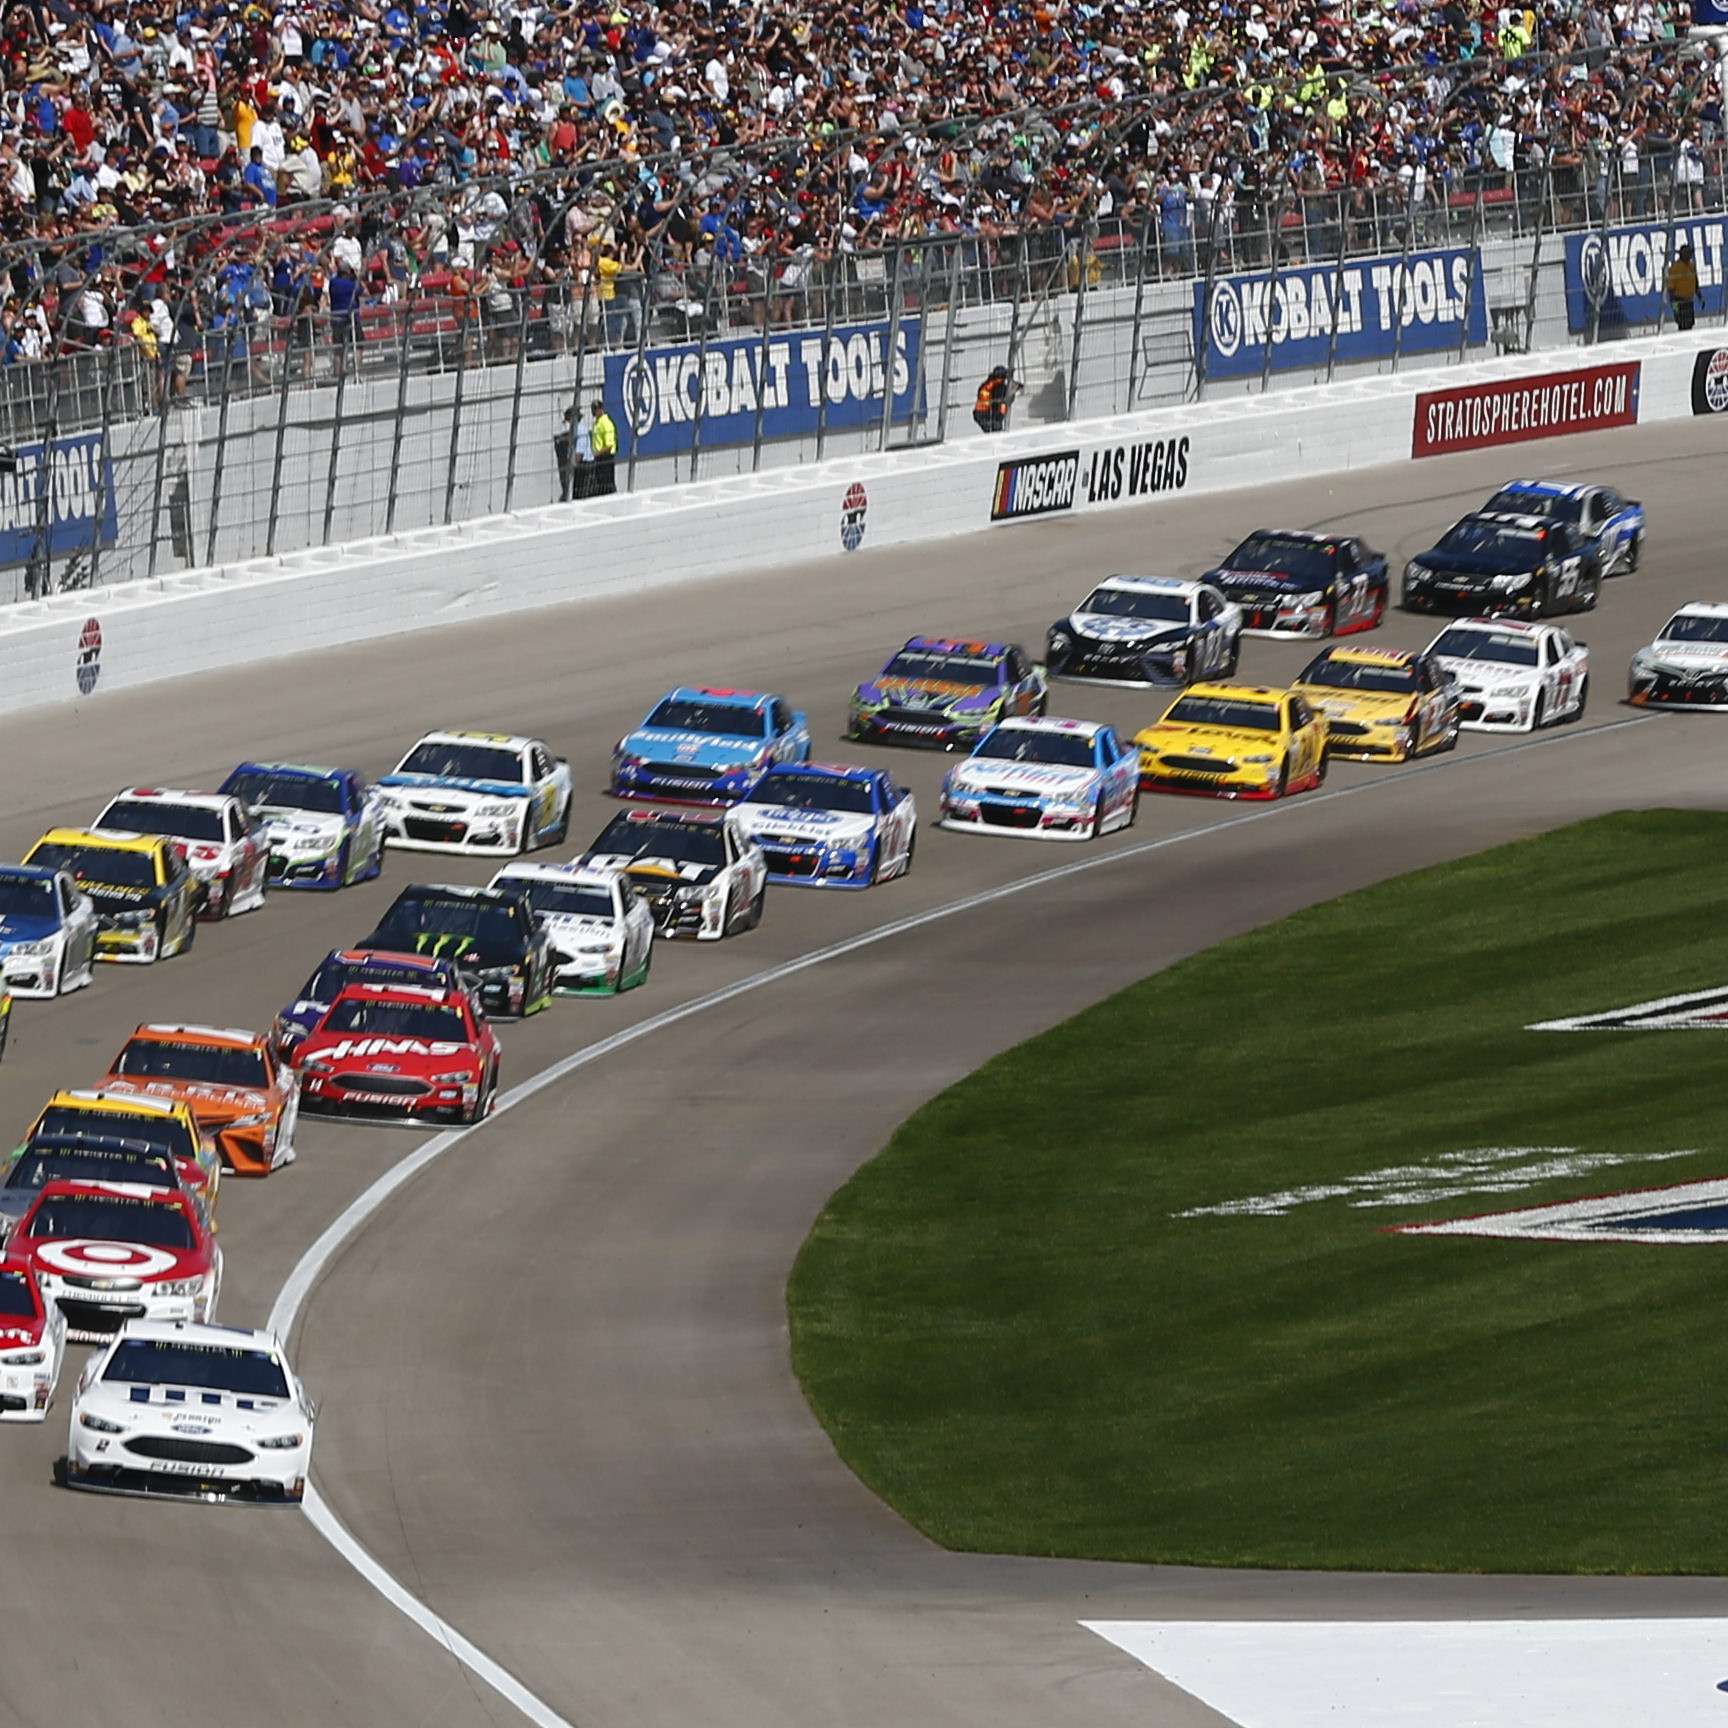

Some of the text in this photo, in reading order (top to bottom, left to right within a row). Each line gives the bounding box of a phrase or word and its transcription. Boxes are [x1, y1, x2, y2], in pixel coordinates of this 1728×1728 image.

[1241, 268, 1363, 346] KOBALT
[1372, 256, 1470, 331] TOOLS
[656, 331, 909, 423] KOBALT TOOLS
[1426, 374, 1627, 444] STRATOSPHEREHOTEL.COM
[1013, 435, 1190, 512] NASCAR LAS VEGAS
[343, 1092, 418, 1107] FUSION
[149, 1461, 225, 1478] FUSION
